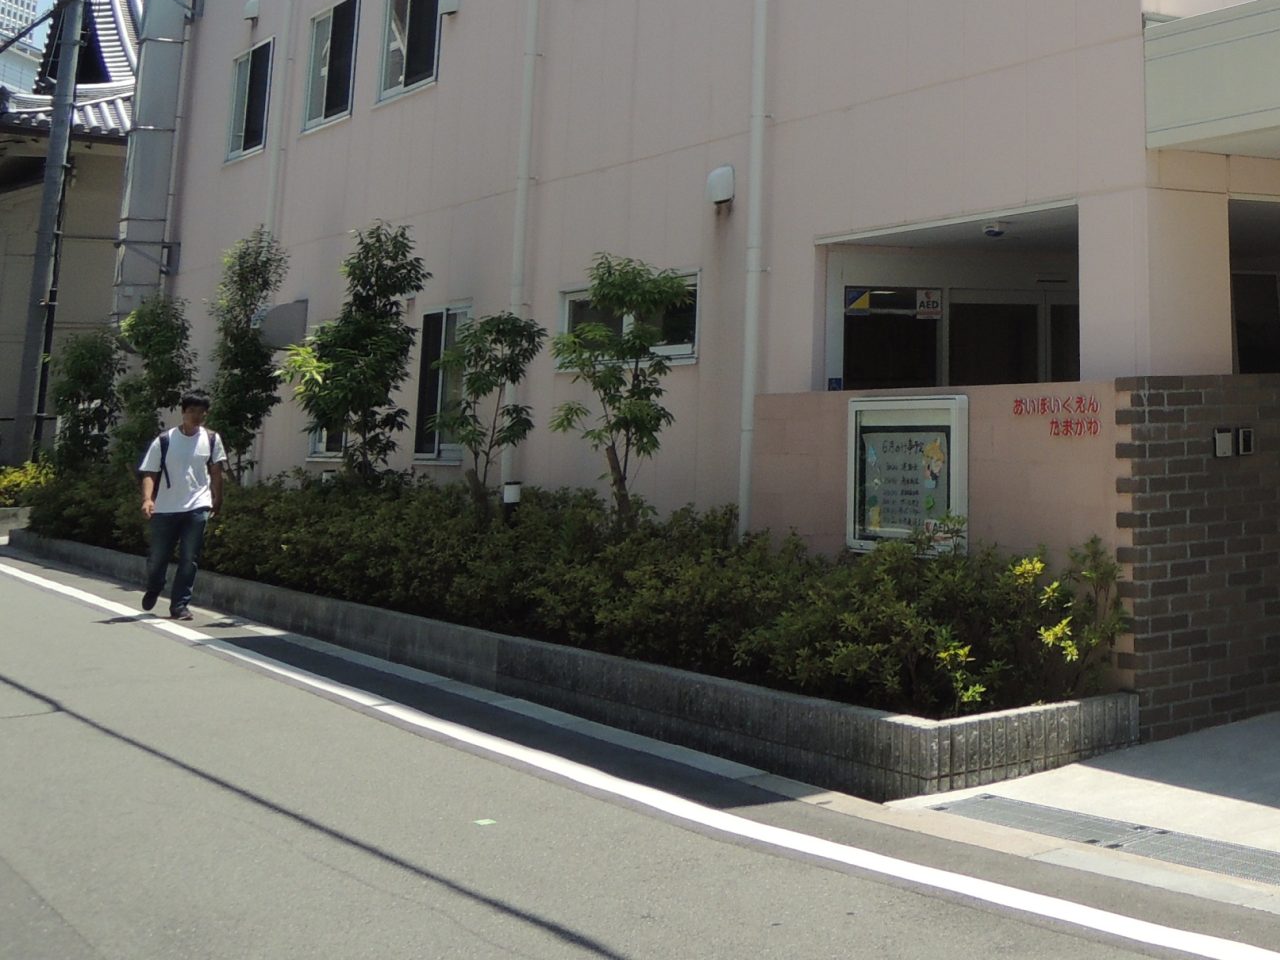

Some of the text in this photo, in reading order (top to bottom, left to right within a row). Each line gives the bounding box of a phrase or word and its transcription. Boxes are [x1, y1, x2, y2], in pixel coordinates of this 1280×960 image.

[919, 300, 939, 310] AED
[1013, 395, 1101, 416] あいほいくえん
